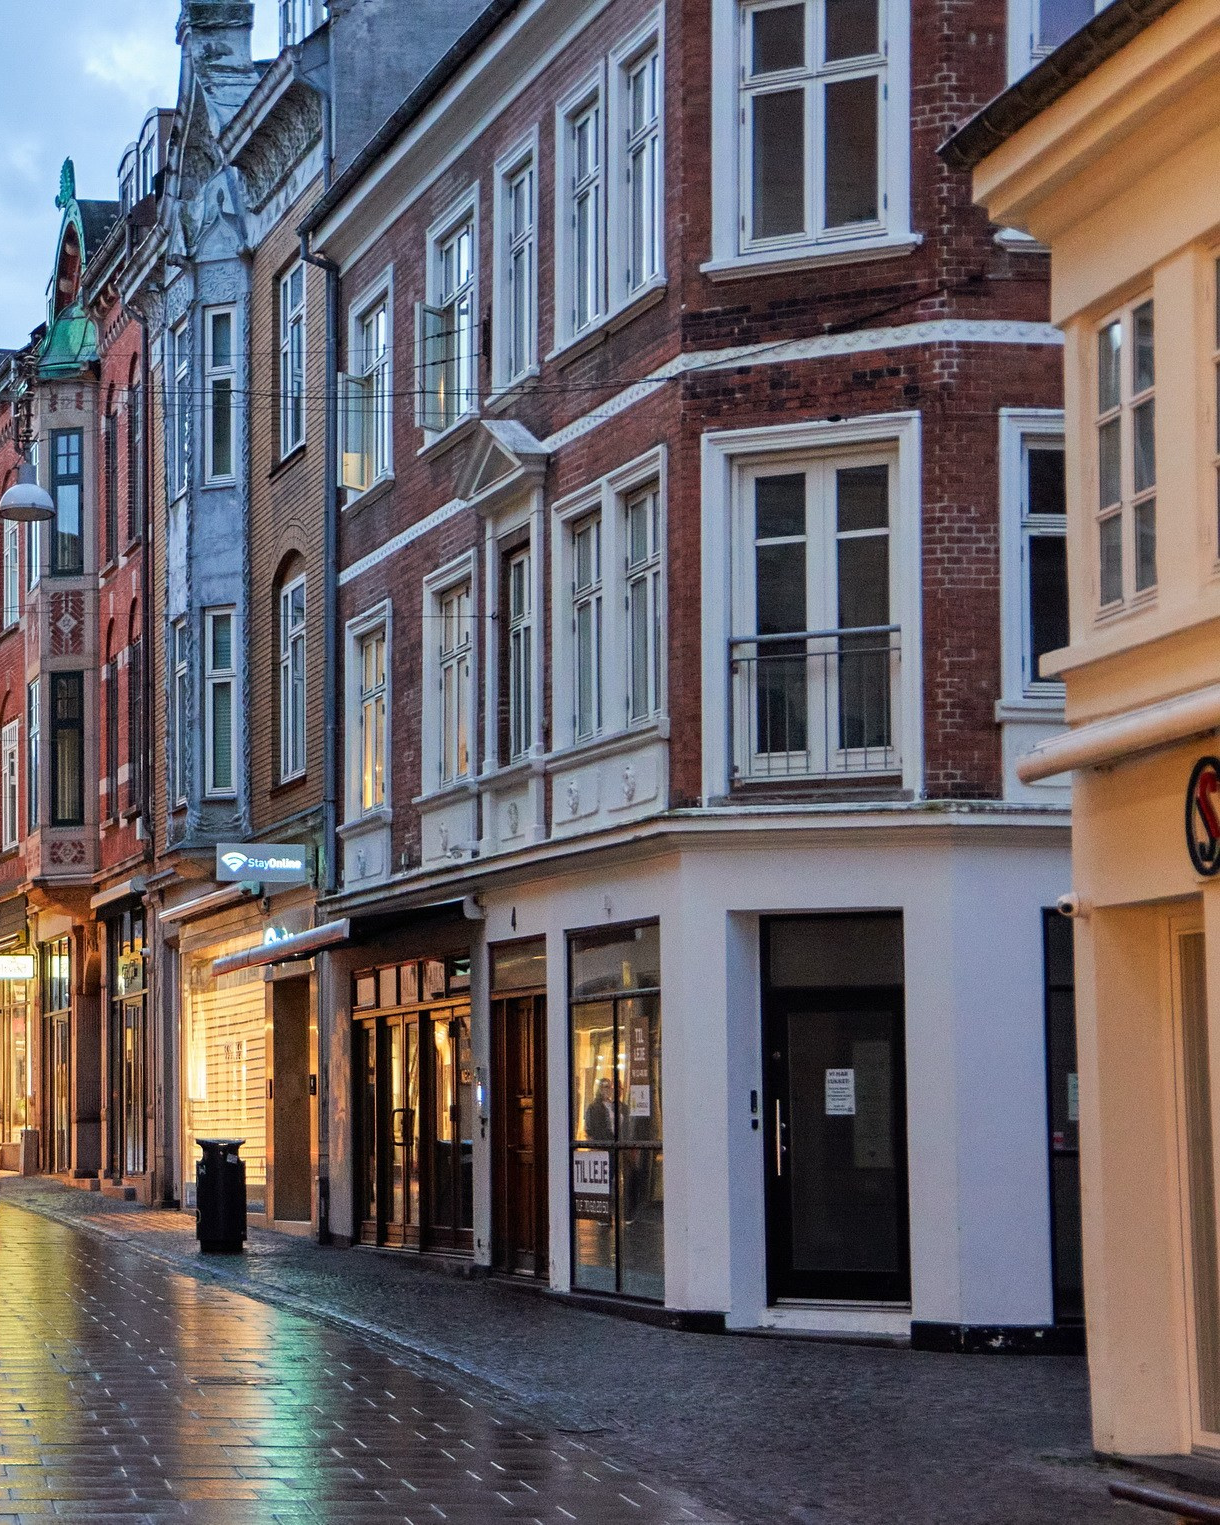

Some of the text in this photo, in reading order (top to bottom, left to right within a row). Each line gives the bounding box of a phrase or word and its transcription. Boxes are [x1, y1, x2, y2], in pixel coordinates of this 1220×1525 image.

[247, 857, 302, 870] StayOnline
[575, 1160, 608, 1184] TIL LEJE
